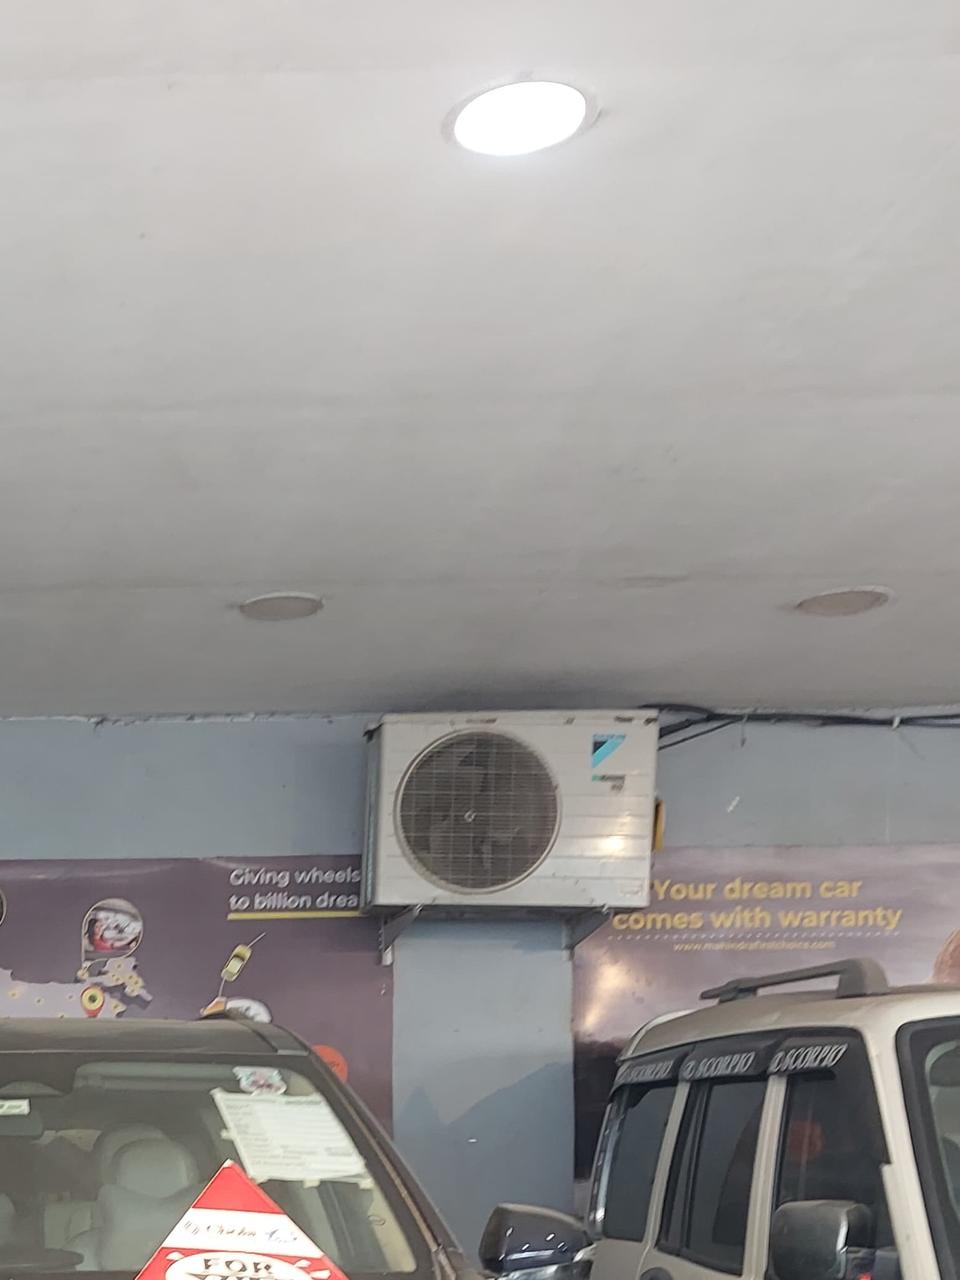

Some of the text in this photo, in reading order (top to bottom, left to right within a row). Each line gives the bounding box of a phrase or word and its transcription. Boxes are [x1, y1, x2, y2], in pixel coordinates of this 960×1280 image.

[229, 867, 361, 888] Giving wheels
[653, 877, 863, 901] Your dream car
[229, 891, 359, 910] to billion drea
[612, 905, 903, 931] comes with warranty
[694, 1051, 756, 1078] SCORPIO
[784, 1043, 849, 1071] SCORPIO
[202, 1257, 273, 1275] FOR
